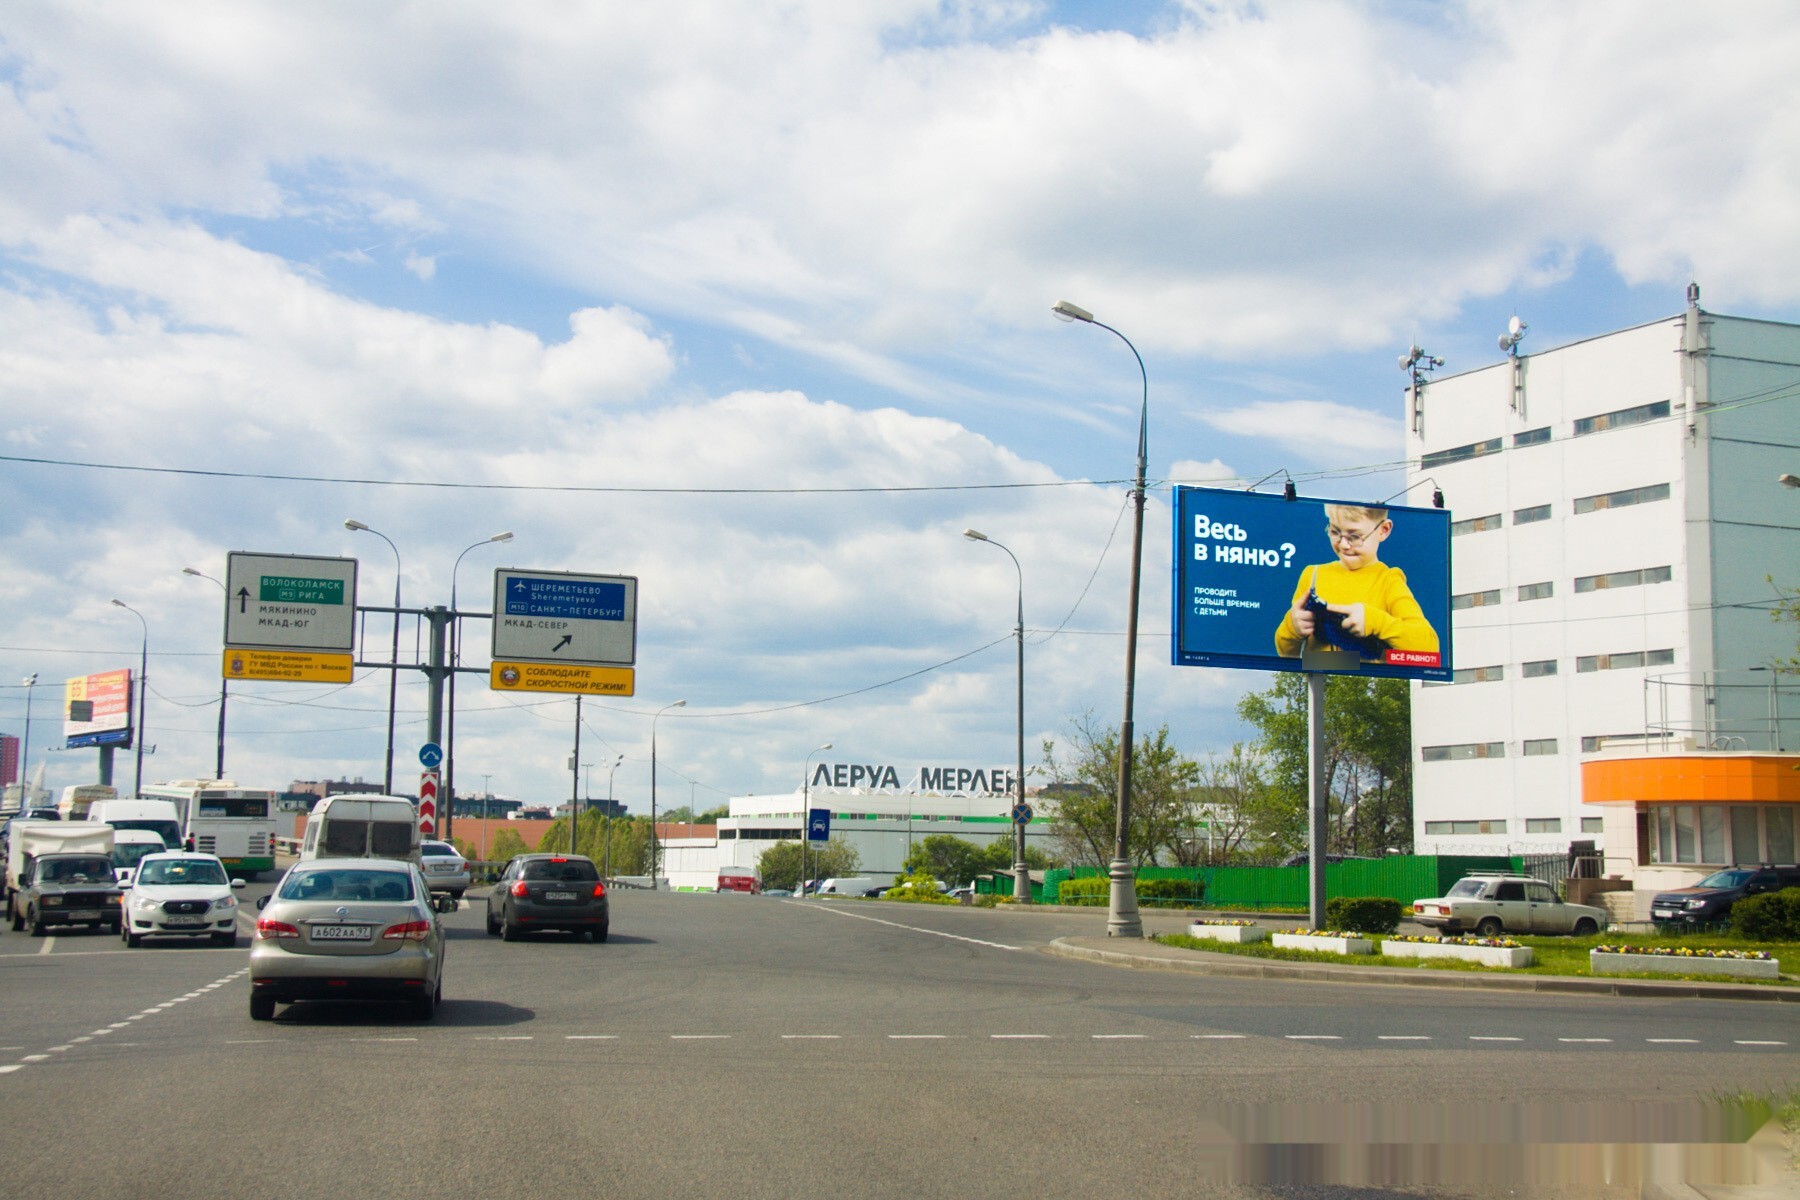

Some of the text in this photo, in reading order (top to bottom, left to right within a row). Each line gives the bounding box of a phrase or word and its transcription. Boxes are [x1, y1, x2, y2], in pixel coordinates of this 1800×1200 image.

[1194, 514, 1247, 542] Весь
[1194, 542, 1296, 568] в няню?
[262, 578, 340, 590] ВОЛОКОЛАМСК
[531, 584, 601, 595] ШЕРЕМЕТЬЕВО
[298, 592, 324, 600] РИГА
[1194, 586, 1237, 597] ПРОВОДИТЕ
[531, 592, 596, 604] Sheremetyevo
[1194, 597, 1260, 609] БОЛЬШЕ ВРЕМЕНИ
[259, 606, 317, 616] МЯКИНИНО
[1200, 608, 1228, 616] ДЕТЬМИ
[258, 618, 310, 628] МКАД-ЮГ
[504, 619, 568, 630] МКАД-СЕВЕР
[250, 653, 281, 661] Телефон
[1390, 652, 1436, 662] ВСЁ РАВНО?!
[526, 667, 592, 678] СОБЛЮДАЙТЕ
[526, 678, 626, 692] СКОРОСТНОЙ РЕЖИМ!
[811, 764, 901, 788] ЛЕРУА
